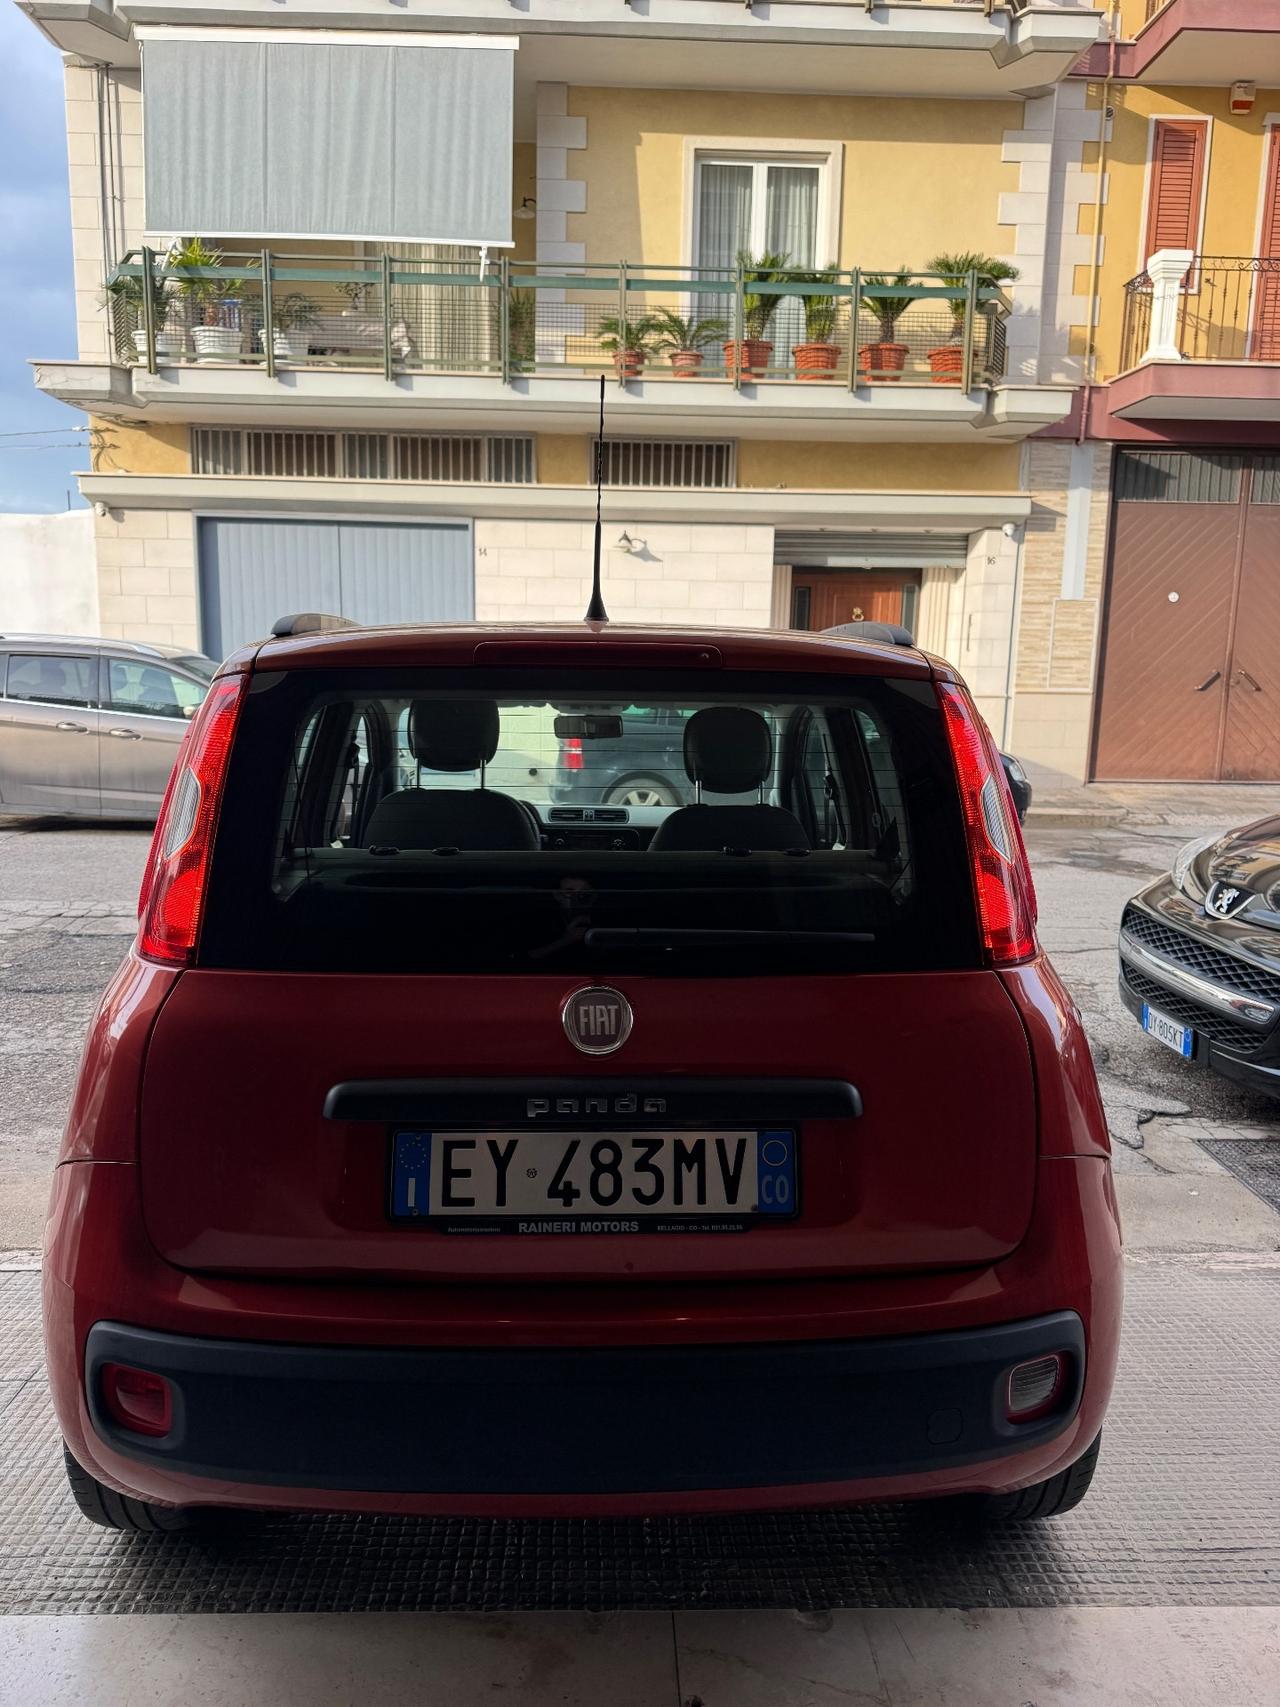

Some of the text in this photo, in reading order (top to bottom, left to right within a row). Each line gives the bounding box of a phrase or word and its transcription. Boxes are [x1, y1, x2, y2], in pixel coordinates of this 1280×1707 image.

[579, 1005, 619, 1036] FIAT
[526, 1093, 667, 1118] panda
[441, 1138, 747, 1207] EY 483MV
[407, 1178, 416, 1207] I
[761, 1175, 789, 1205] CO
[518, 1221, 640, 1233] RAINERI MOTORS
